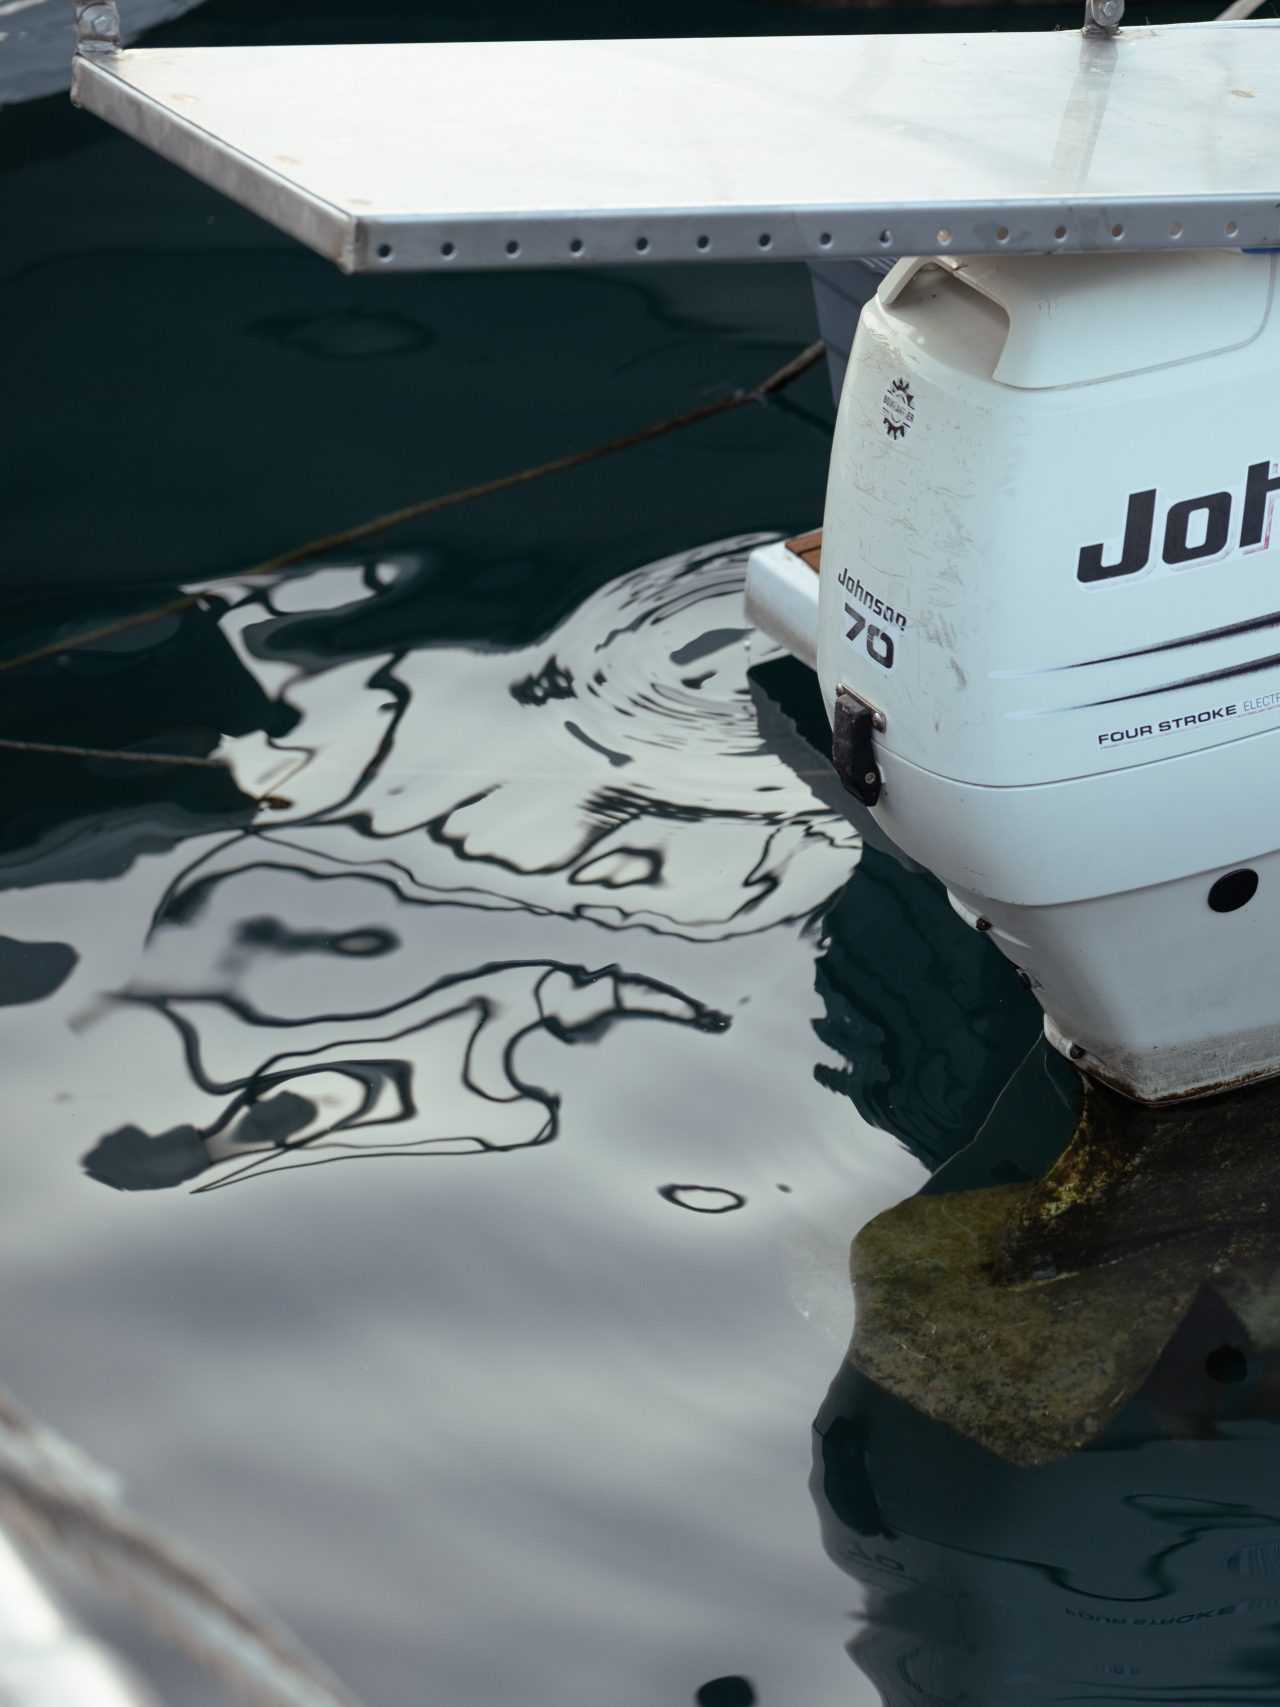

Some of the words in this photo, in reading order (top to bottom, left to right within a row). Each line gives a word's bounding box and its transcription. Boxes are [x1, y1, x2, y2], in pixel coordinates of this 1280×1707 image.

[838, 567, 907, 631] Johnson
[844, 602, 894, 669] 70
[1098, 724, 1152, 744] FOUR
[1158, 704, 1237, 732] STROKE
